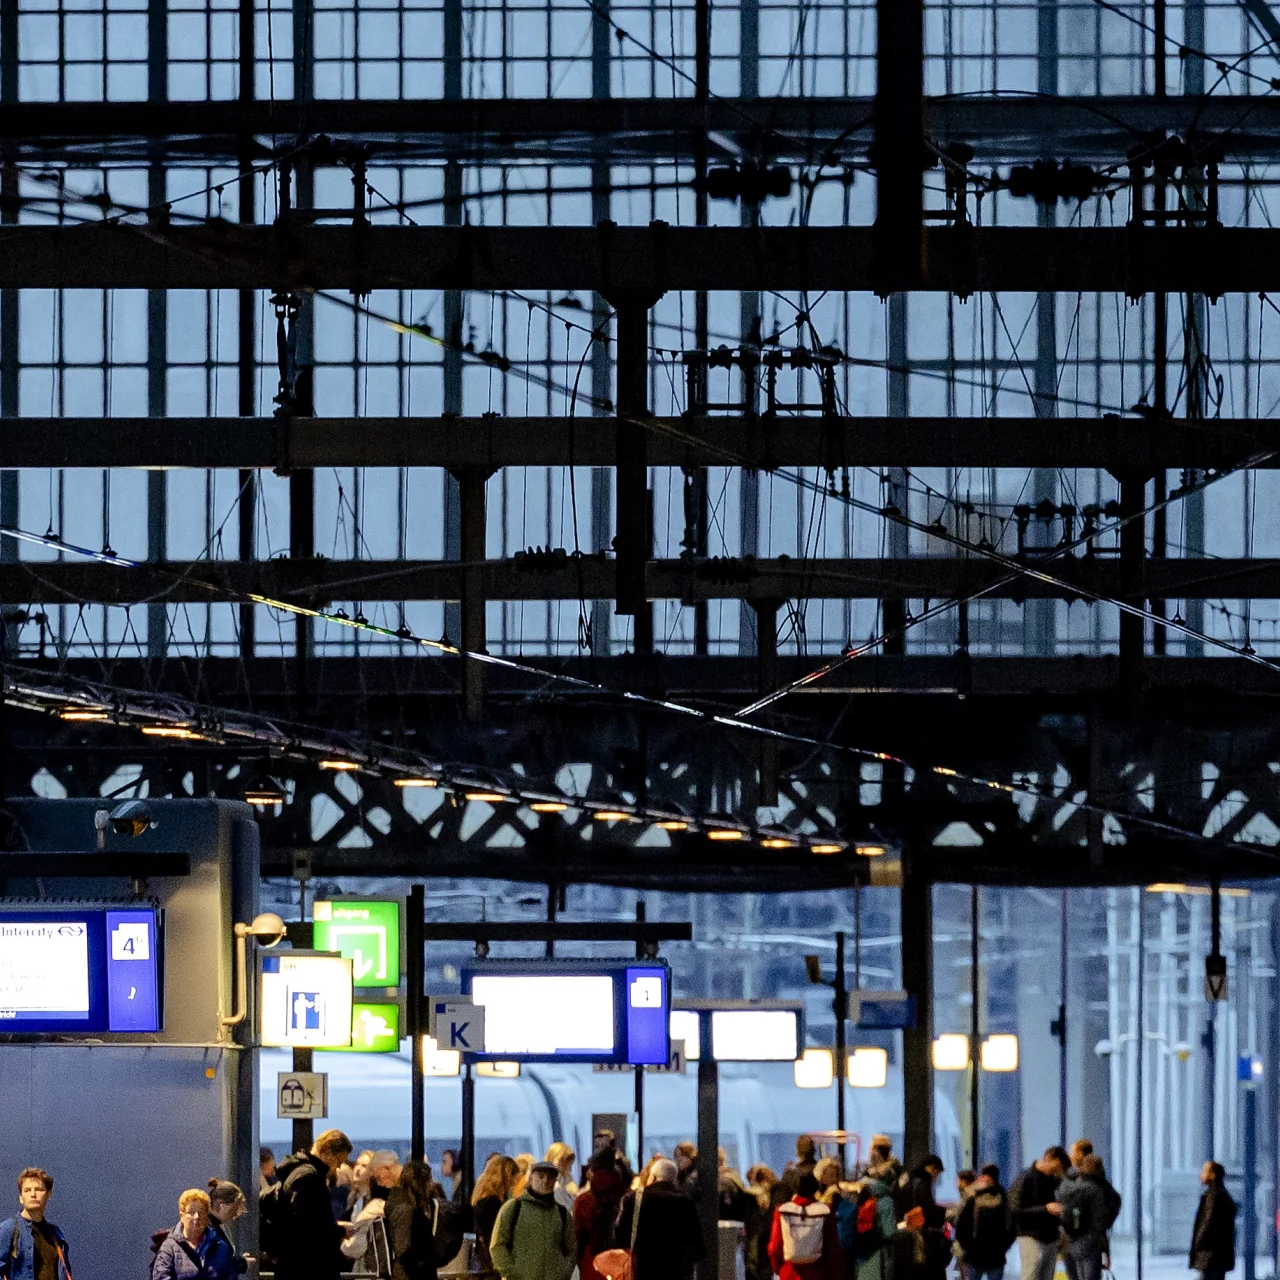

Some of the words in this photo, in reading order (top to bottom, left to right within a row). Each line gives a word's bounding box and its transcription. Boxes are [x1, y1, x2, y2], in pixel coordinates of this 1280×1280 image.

[333, 908, 369, 920] uitgang
[1, 926, 54, 940] Intercity
[451, 1021, 471, 1048] K
